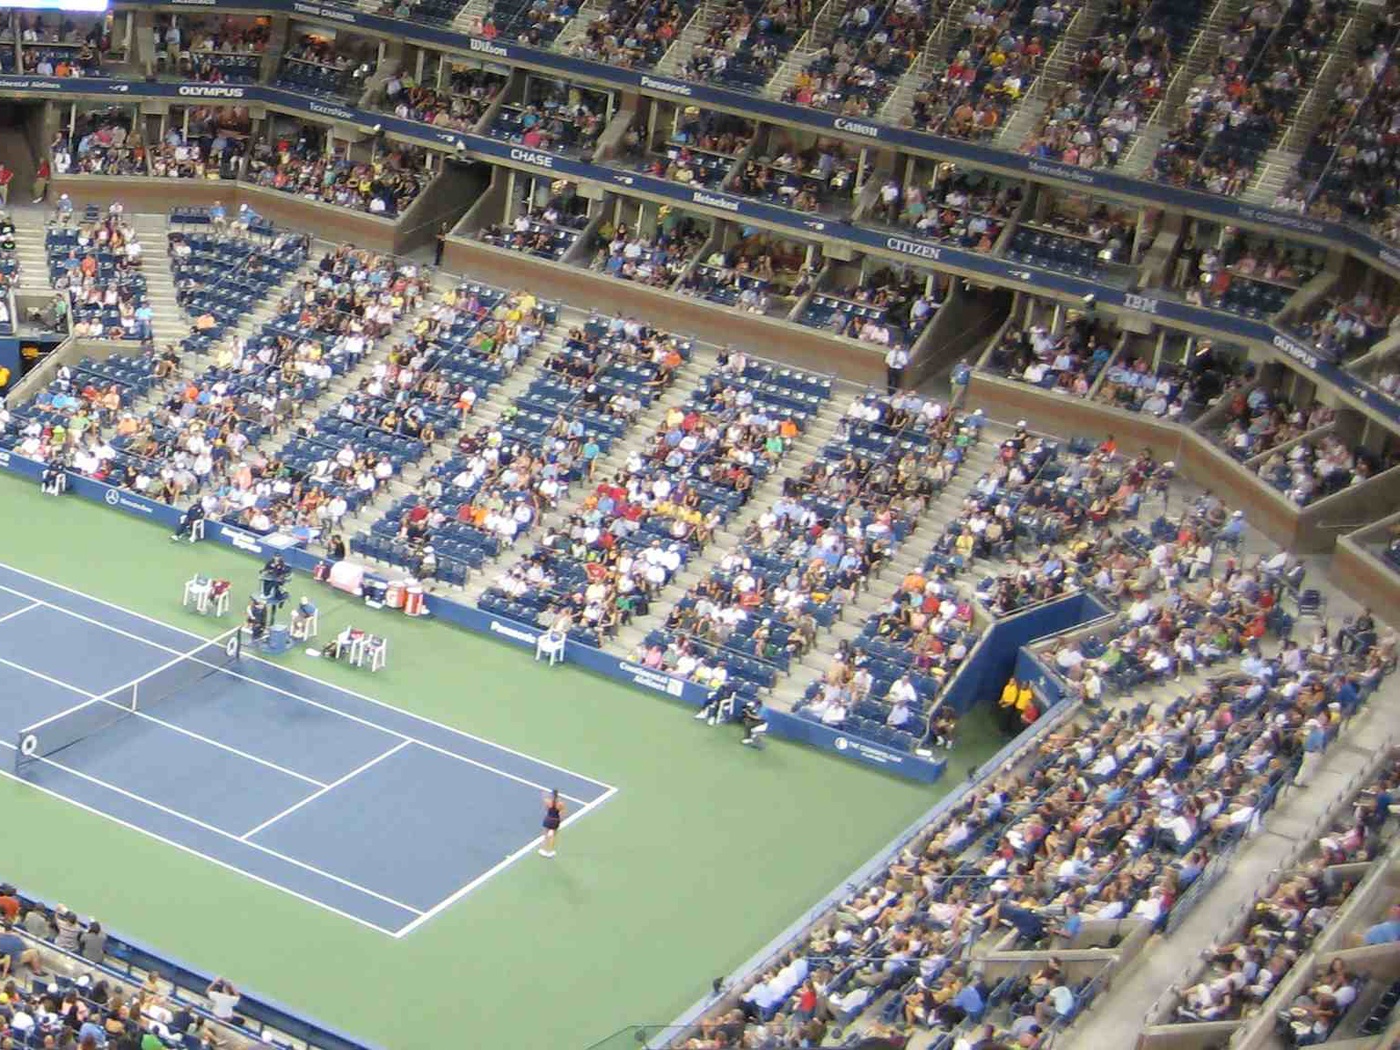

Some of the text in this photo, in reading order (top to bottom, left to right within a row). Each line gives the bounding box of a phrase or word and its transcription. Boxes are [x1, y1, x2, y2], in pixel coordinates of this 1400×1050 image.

[470, 38, 507, 56] Wilson
[179, 86, 243, 97] OLYMPUS
[641, 76, 691, 95] Panasonic
[834, 118, 878, 136] Canon
[511, 149, 553, 168] CHASE
[693, 191, 739, 211] Heineken
[887, 237, 941, 259] CITIZEN
[1123, 293, 1158, 313] IBM
[1273, 335, 1317, 369] OLYMPUS
[491, 621, 537, 643] Panasonic
[619, 661, 669, 684] Continental
